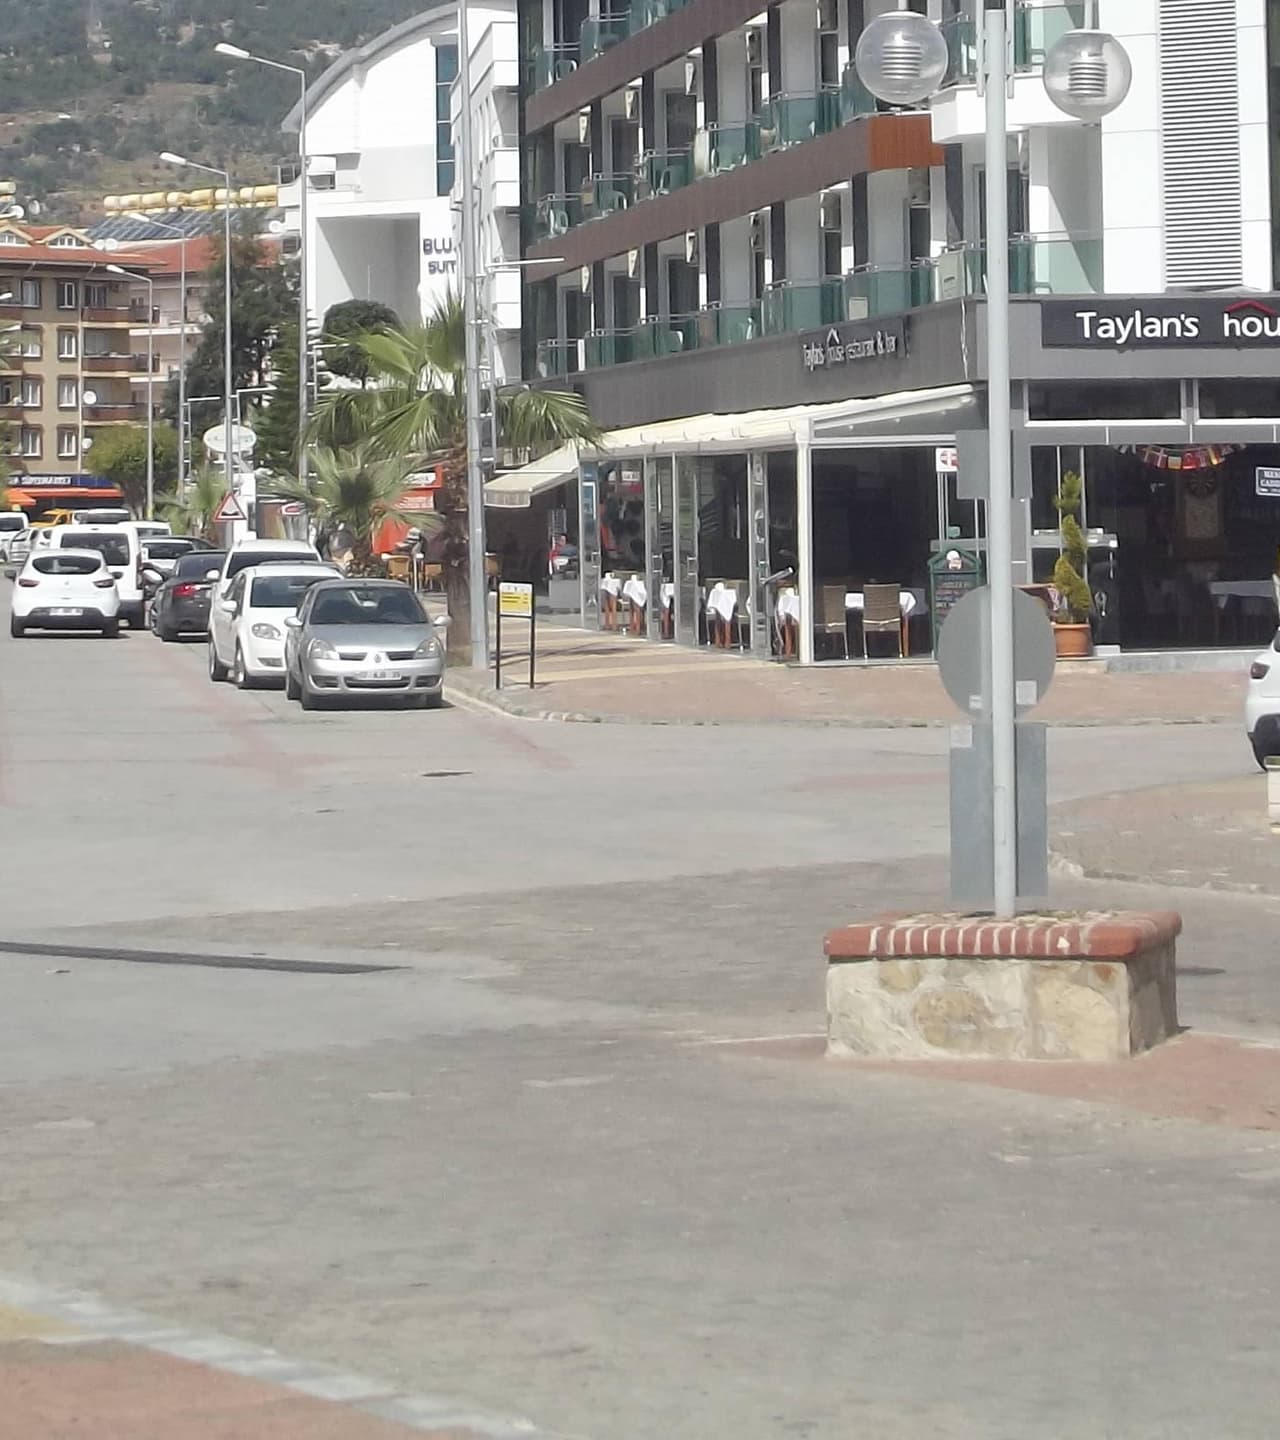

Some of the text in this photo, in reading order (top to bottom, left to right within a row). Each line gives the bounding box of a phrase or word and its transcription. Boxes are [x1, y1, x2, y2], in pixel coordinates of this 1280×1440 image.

[422, 237, 453, 255] BLU
[428, 260, 457, 275] SUIT
[1075, 310, 1199, 344] Taylan's
